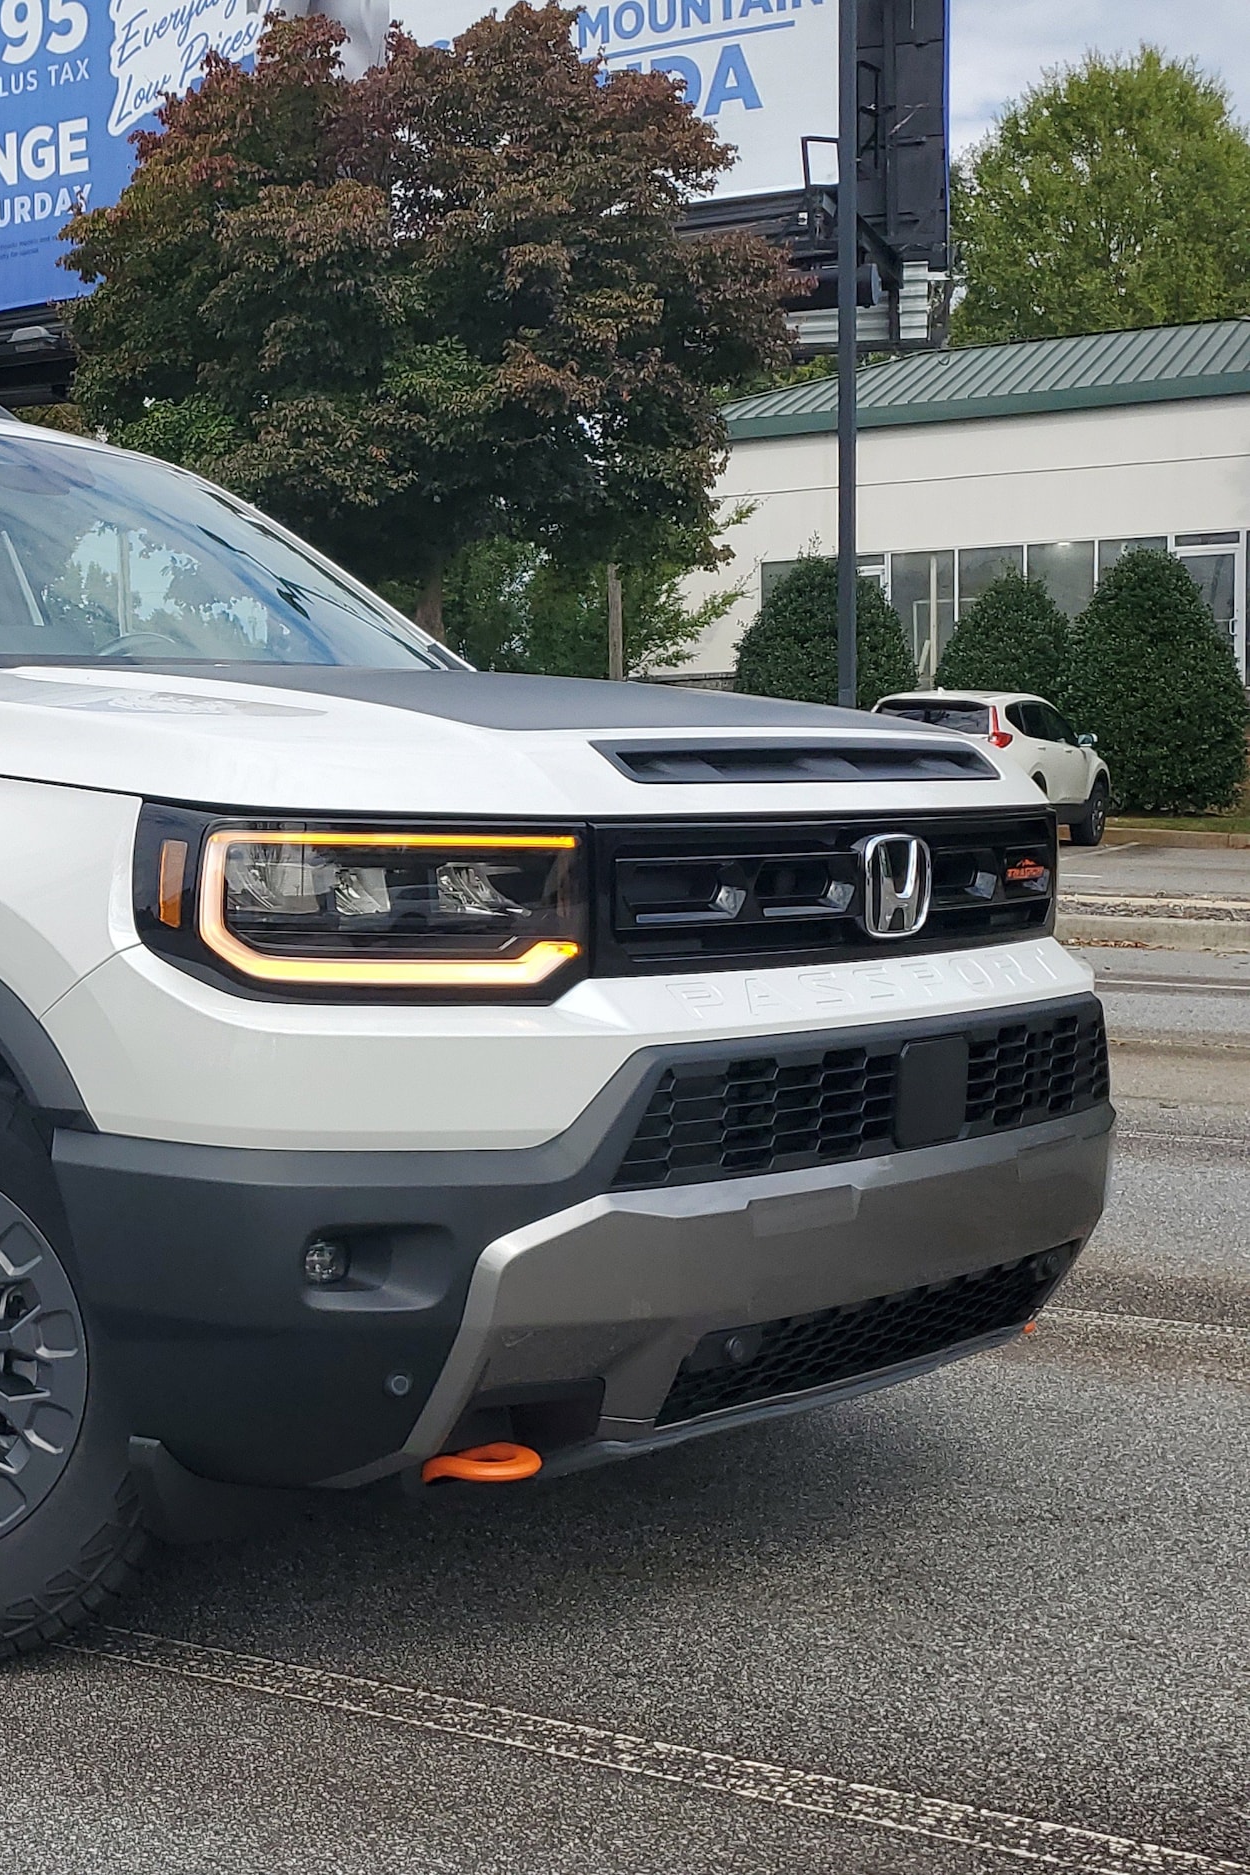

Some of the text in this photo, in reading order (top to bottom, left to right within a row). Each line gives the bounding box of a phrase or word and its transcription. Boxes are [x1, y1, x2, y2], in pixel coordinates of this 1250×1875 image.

[117, 0, 237, 69] Every
[578, 0, 824, 48] MOUNT
[47, 57, 90, 87] TAX
[115, 74, 171, 127] Low
[666, 947, 1058, 1019] PASSPORT
